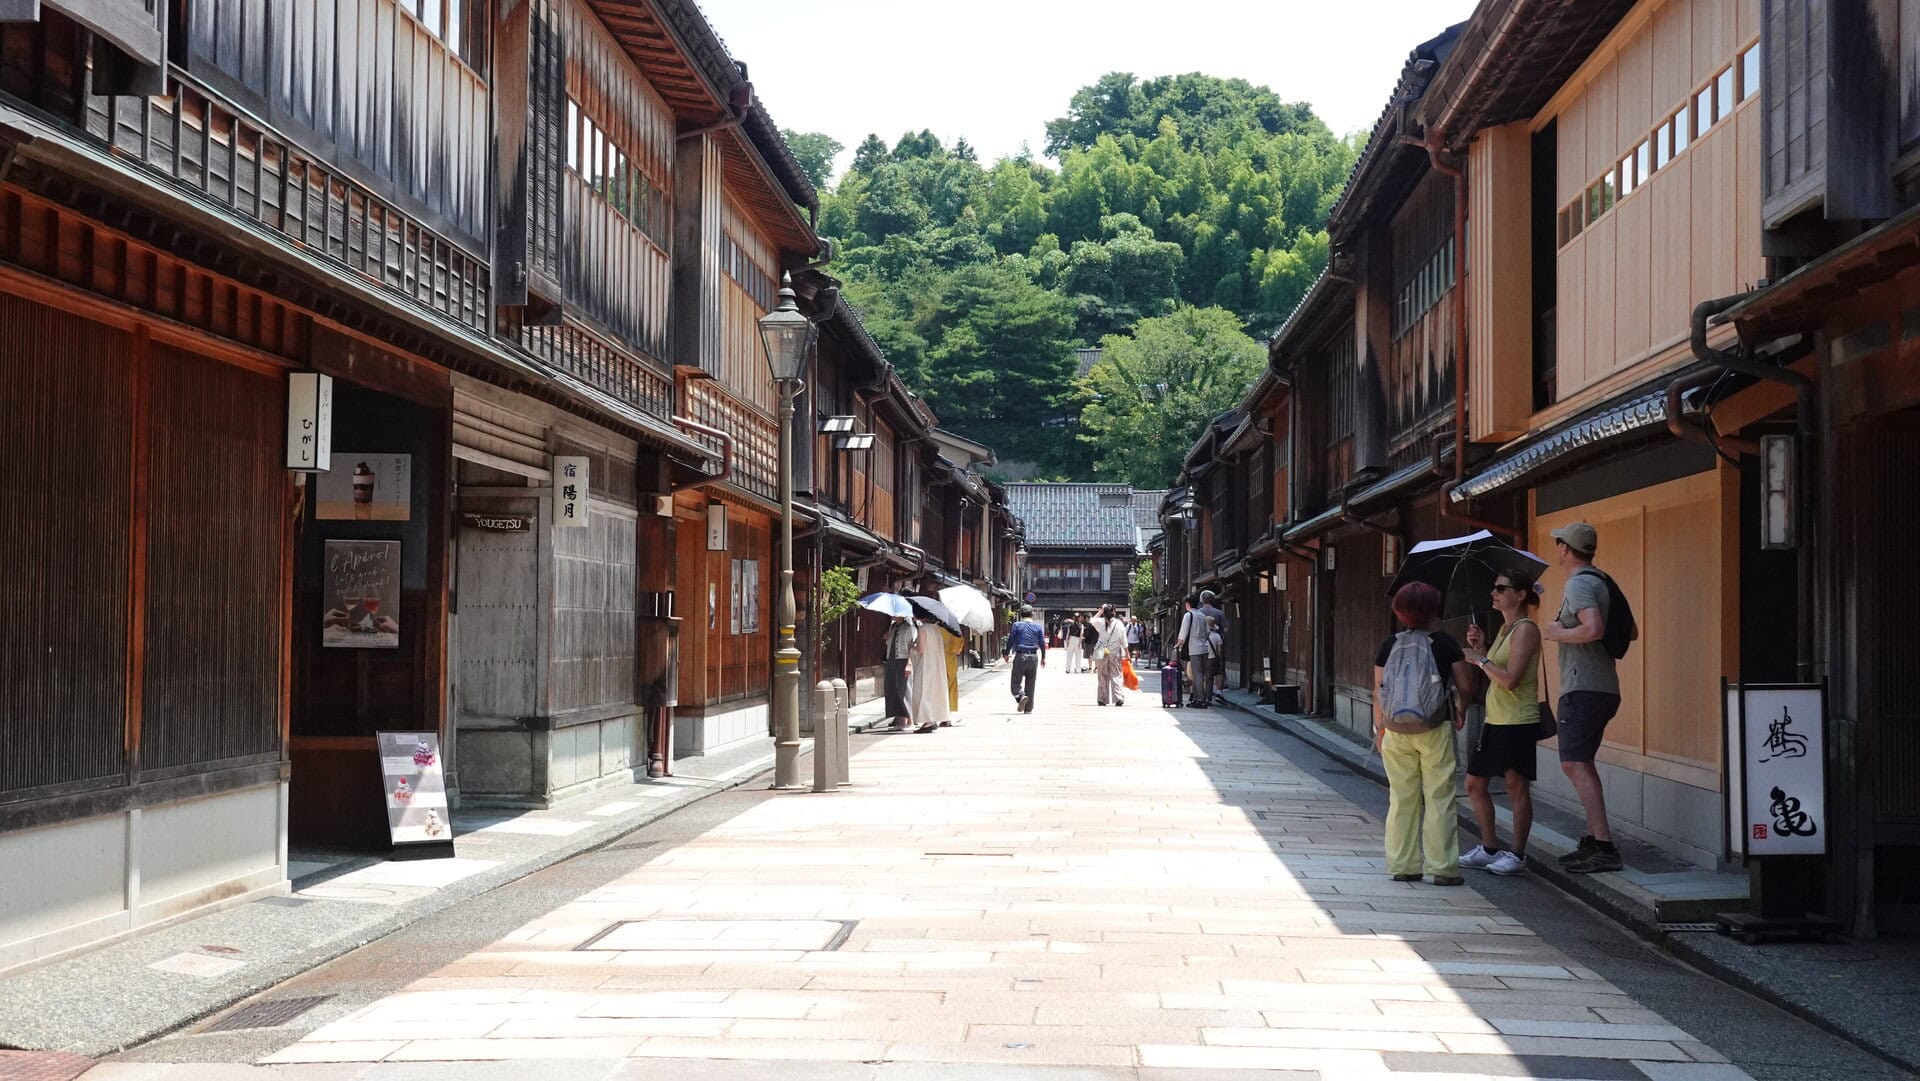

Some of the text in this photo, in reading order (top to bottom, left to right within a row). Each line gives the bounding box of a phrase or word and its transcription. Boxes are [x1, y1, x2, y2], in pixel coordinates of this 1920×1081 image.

[302, 418, 313, 461] ひがし
[475, 518, 522, 529] YOUGETSU
